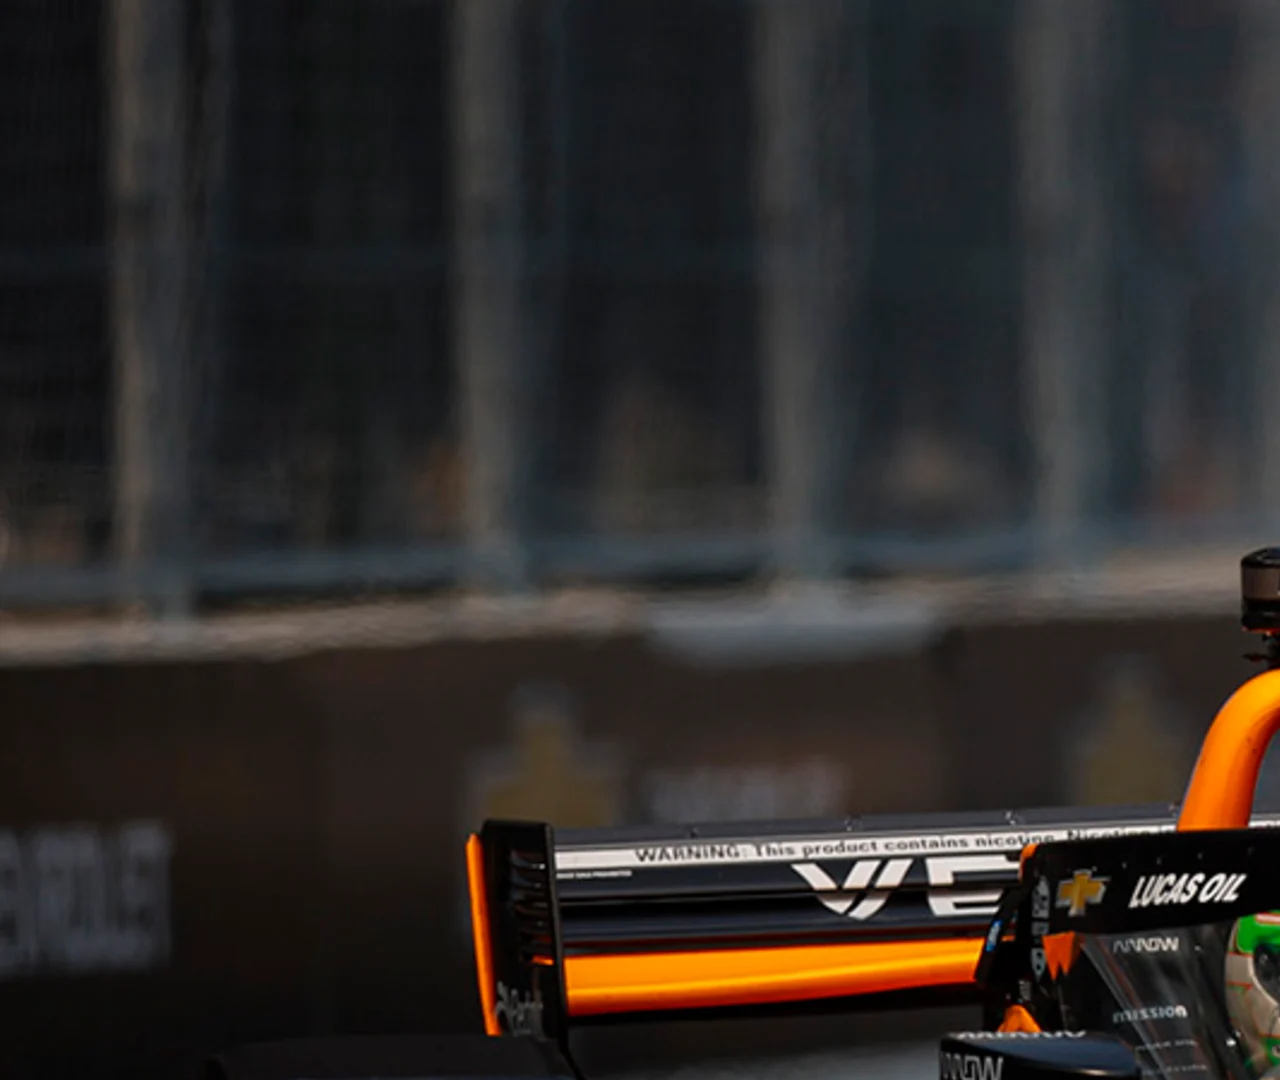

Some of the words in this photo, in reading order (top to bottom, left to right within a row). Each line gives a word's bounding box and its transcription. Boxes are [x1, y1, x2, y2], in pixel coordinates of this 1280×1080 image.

[755, 841, 795, 858] This
[803, 841, 878, 858] product
[884, 837, 969, 852] contains
[1127, 872, 1206, 910] LUCAS
[1197, 872, 1248, 904] OIL
